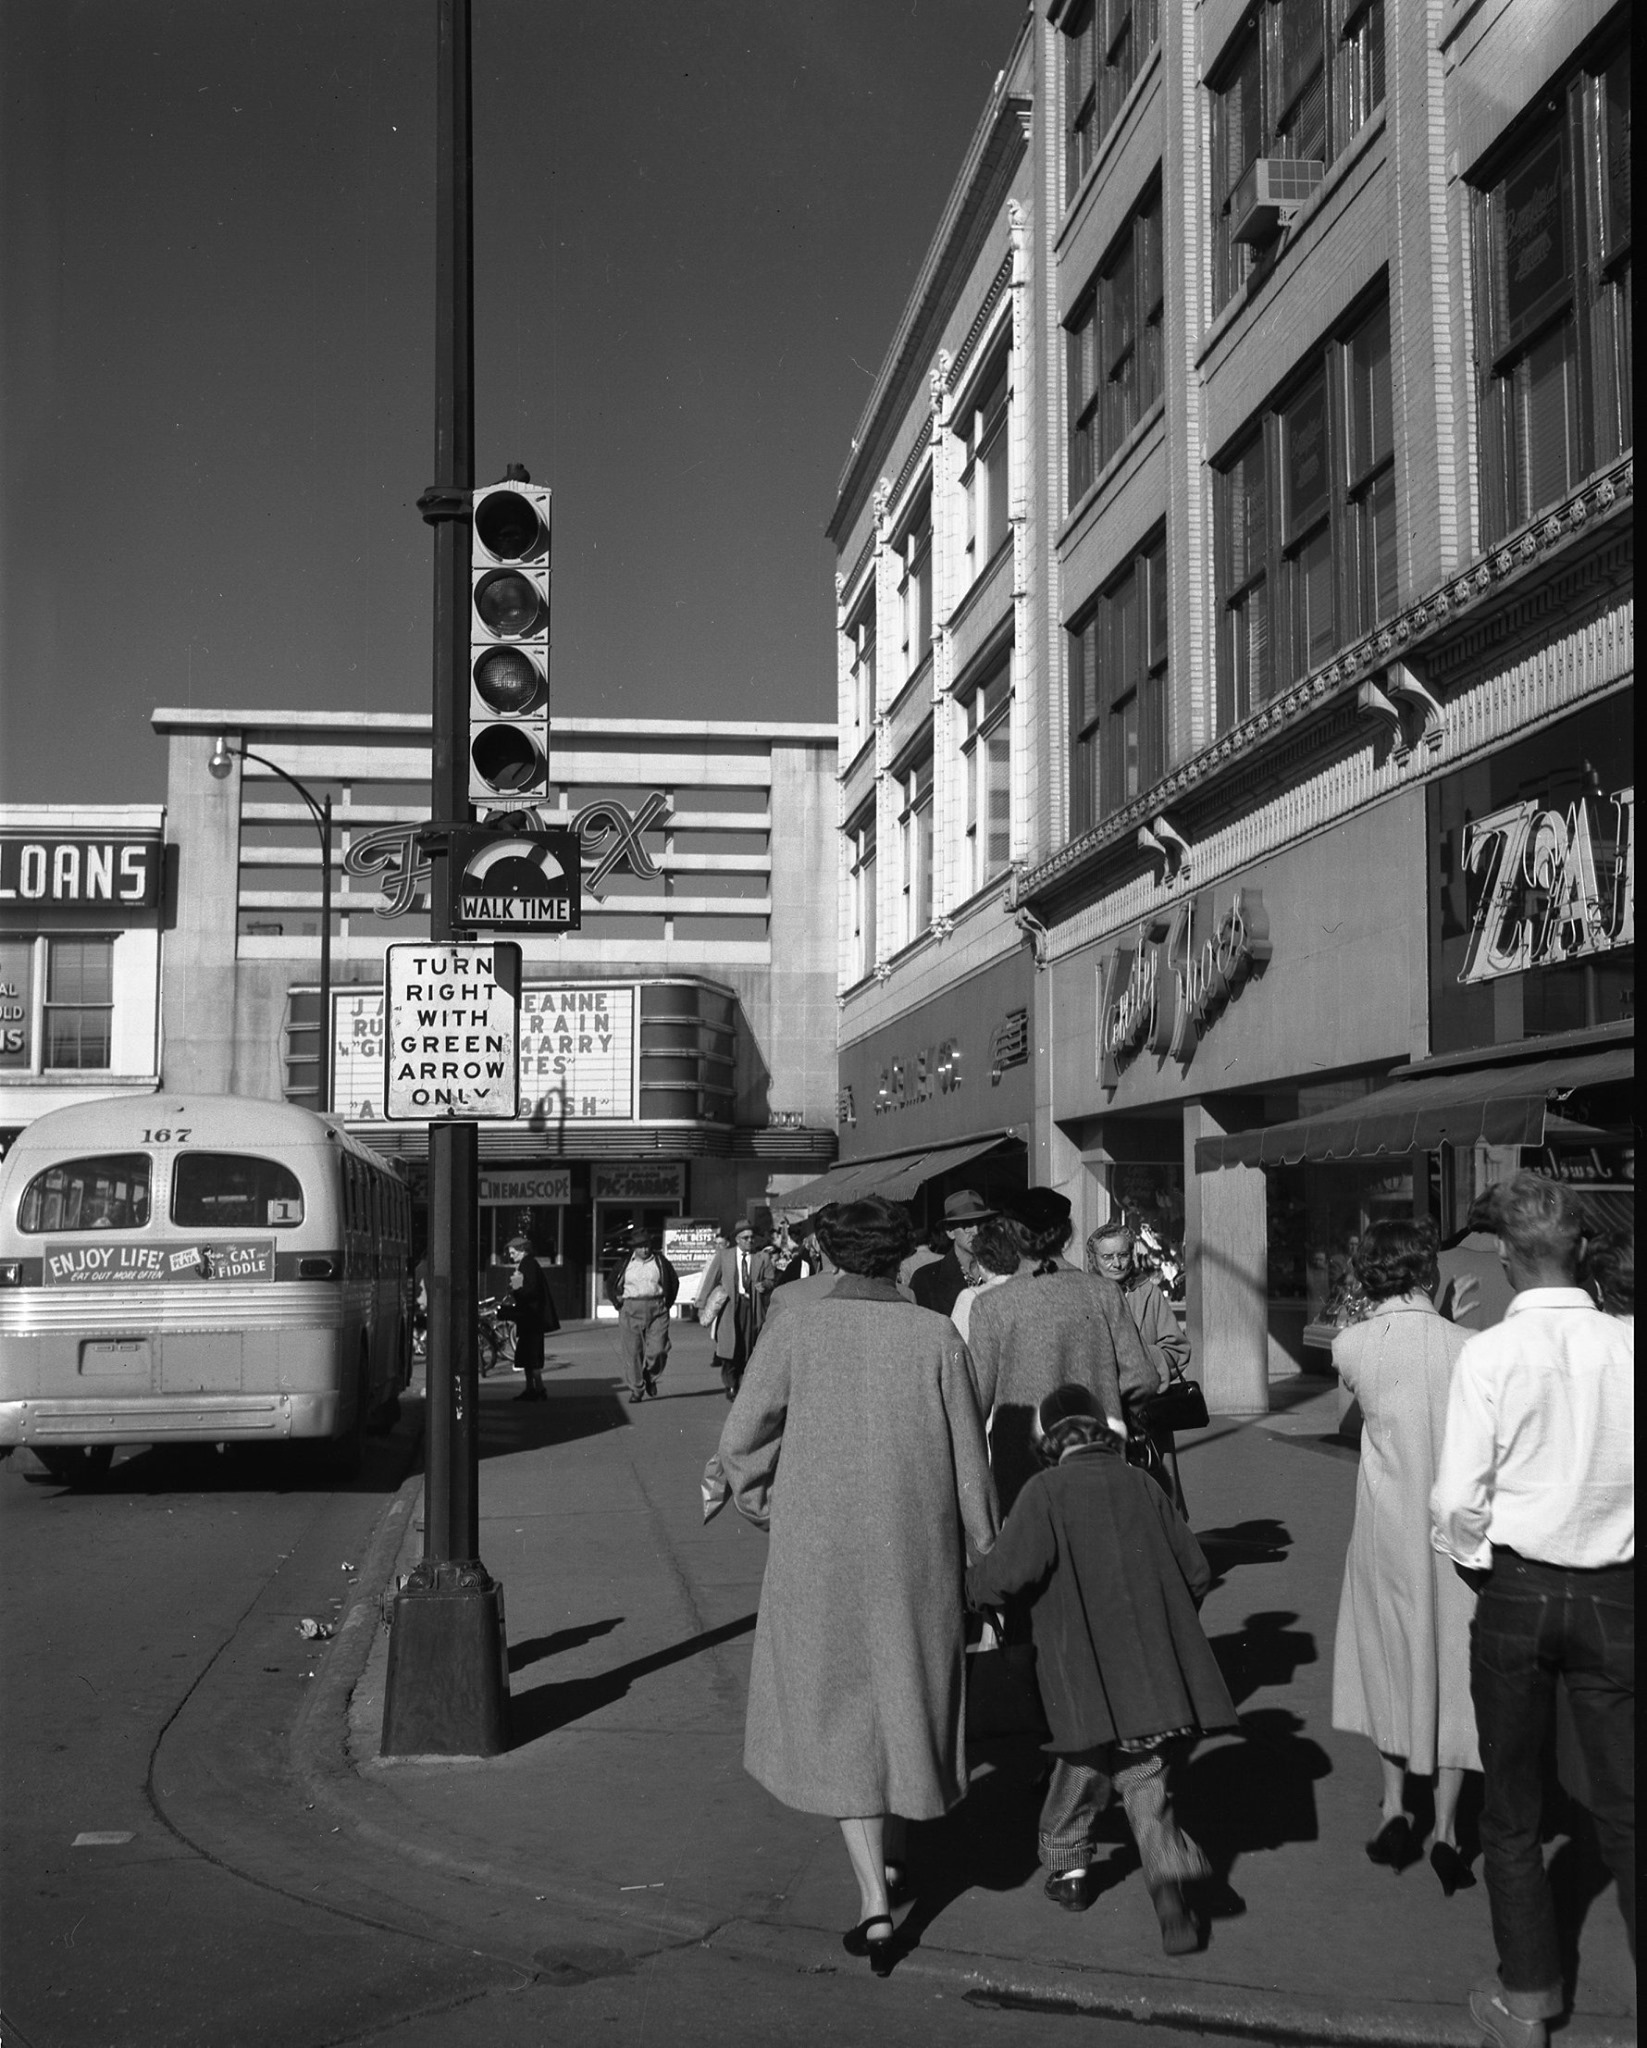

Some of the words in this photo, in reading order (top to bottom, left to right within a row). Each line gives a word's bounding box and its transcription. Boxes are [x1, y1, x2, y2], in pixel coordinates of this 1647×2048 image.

[344, 791, 667, 918] FX
[0, 844, 146, 899] LOANS
[462, 898, 514, 919] WALK
[519, 898, 568, 919] TIME
[413, 958, 492, 975] TURN
[406, 984, 498, 1001] RIGHT
[417, 1010, 488, 1027] WITH
[401, 1036, 503, 1053] GREEN
[397, 1062, 505, 1080] ARROW
[412, 1088, 491, 1106] ONLY
[141, 1128, 192, 1143] 167
[276, 1202, 293, 1220] 1
[49, 1247, 115, 1277] ENJOY
[120, 1247, 165, 1270] LIFE!
[230, 1247, 257, 1262] CAT
[71, 1271, 90, 1281] EAT
[91, 1271, 112, 1280] OUT
[113, 1270, 136, 1280] MORE
[138, 1270, 165, 1280] OFTEN
[218, 1260, 266, 1278] FIDDLE
